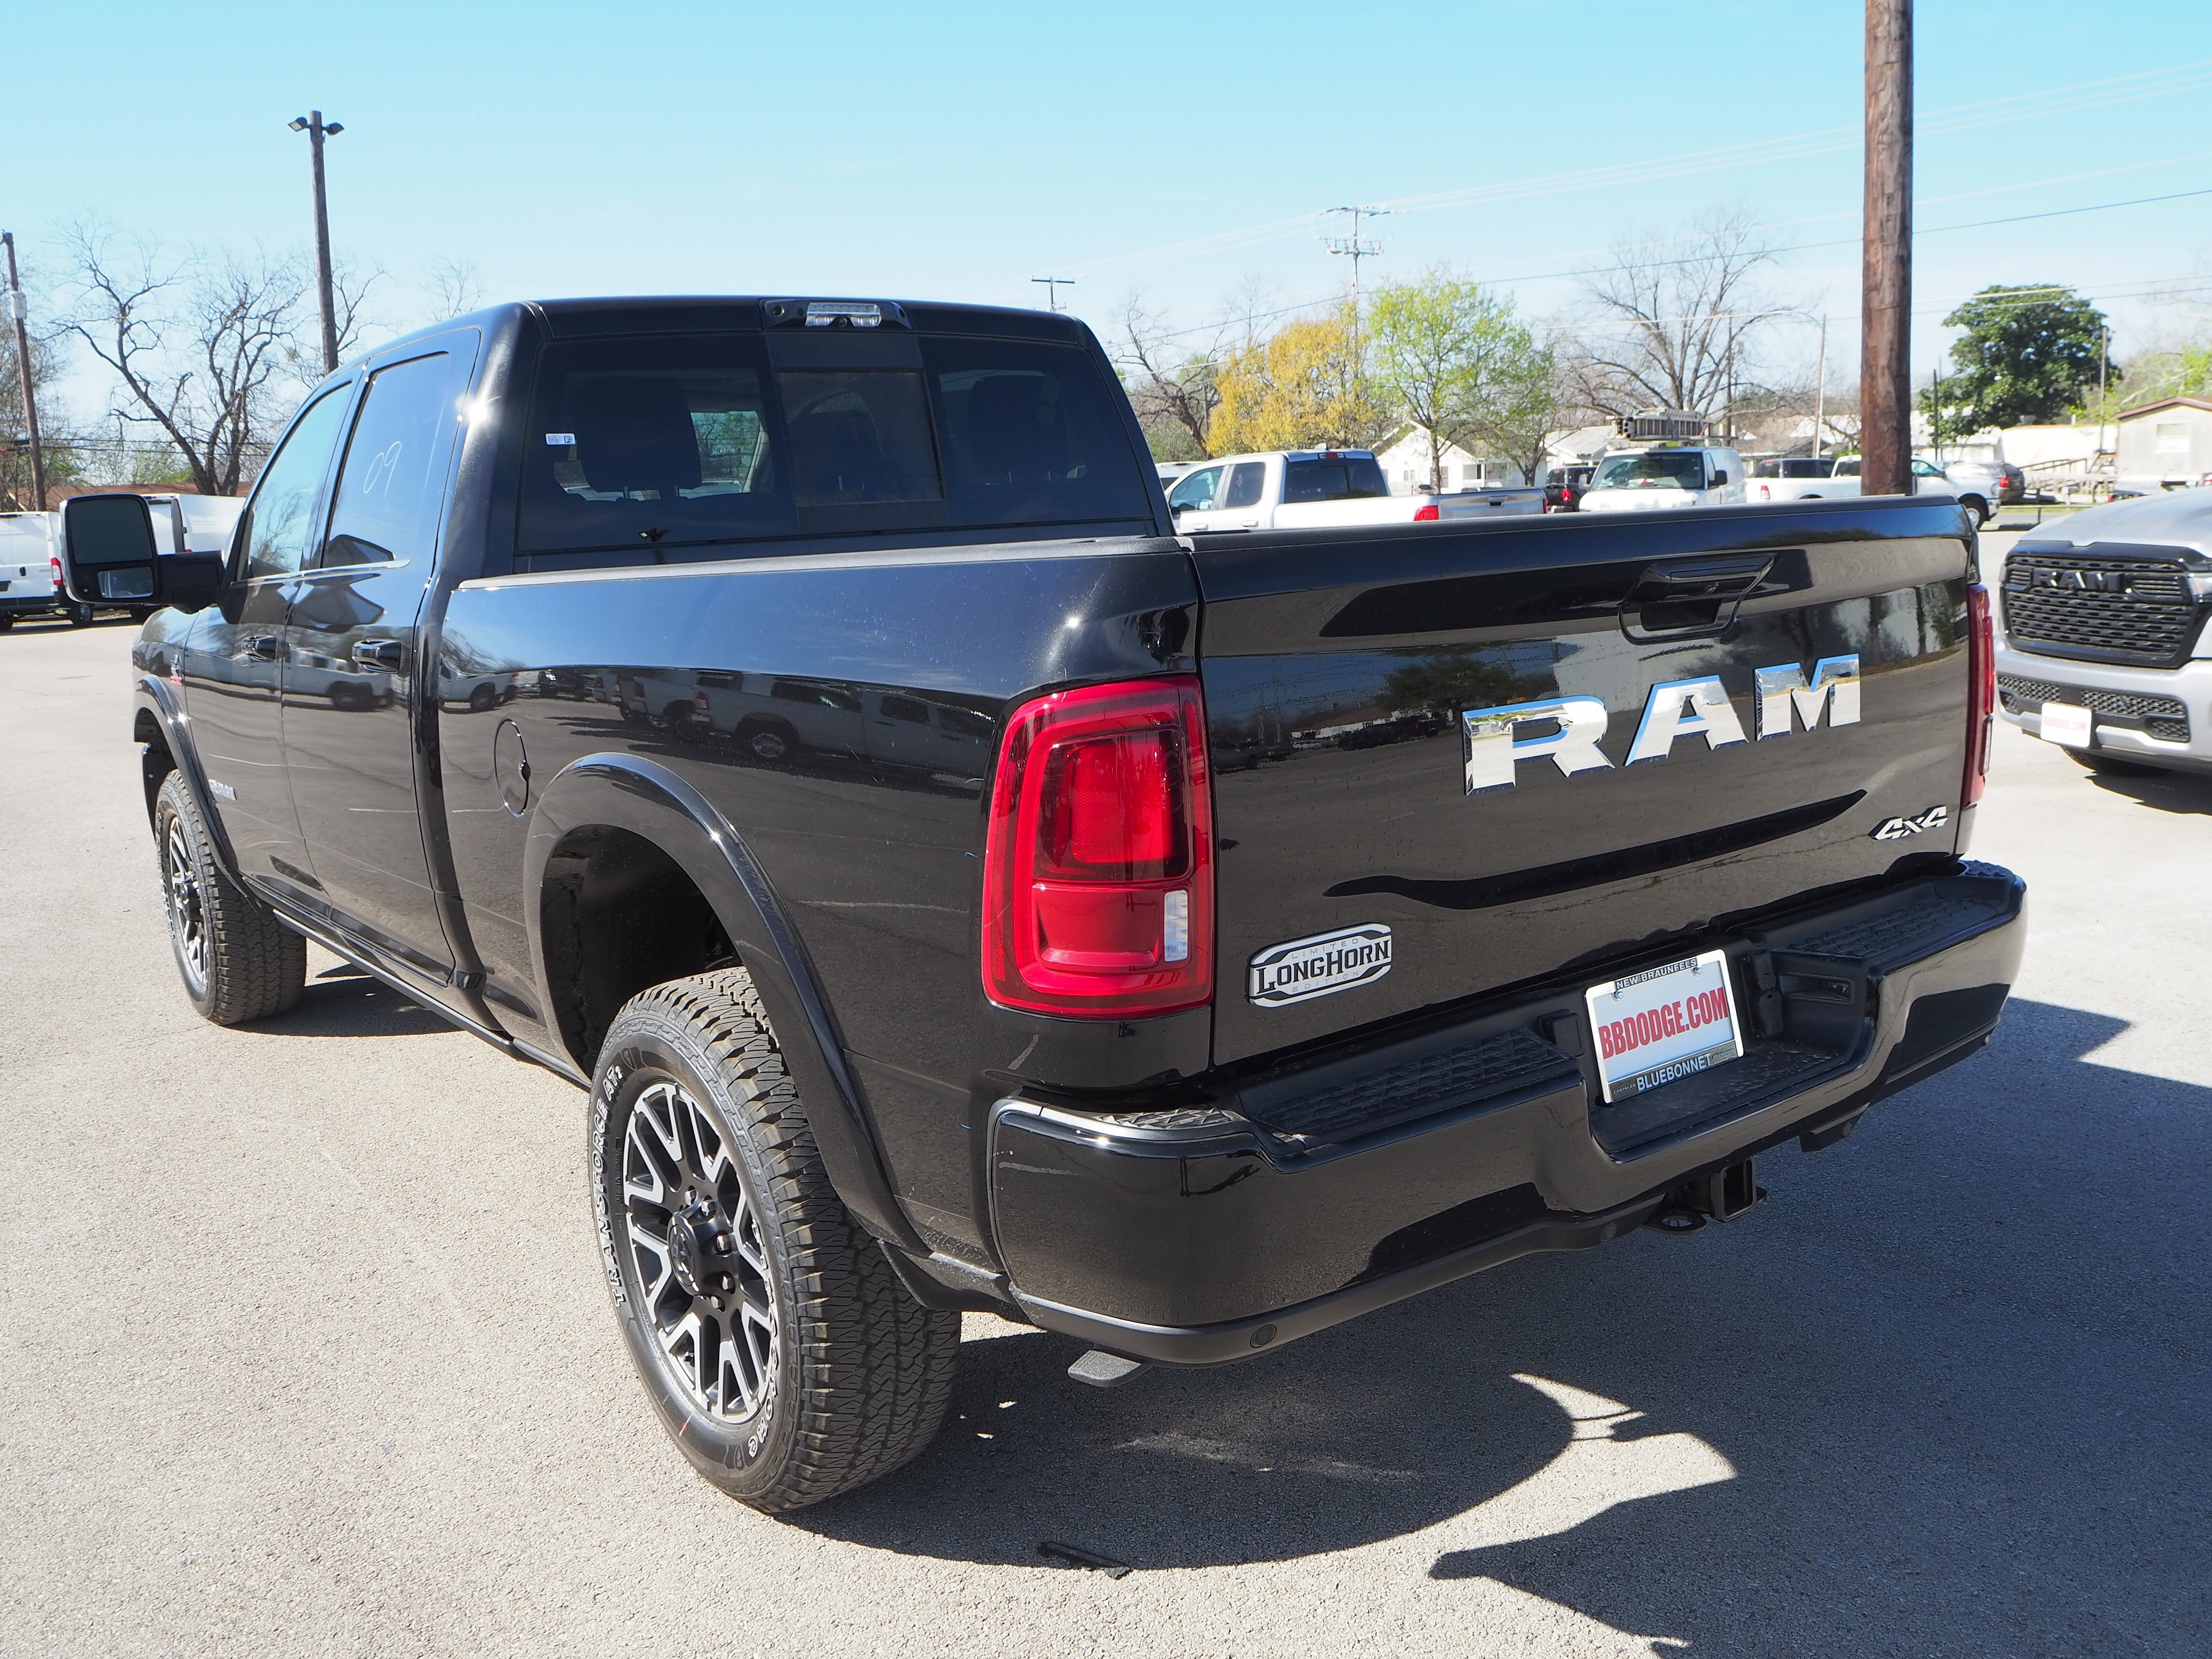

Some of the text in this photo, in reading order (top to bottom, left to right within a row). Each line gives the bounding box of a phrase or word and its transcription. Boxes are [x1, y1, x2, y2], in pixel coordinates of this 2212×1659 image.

[2032, 568, 2125, 593] RAM
[1463, 653, 1861, 796] RAM
[1292, 938, 1358, 959] LIMITED
[1292, 971, 1359, 993] EDITION
[1615, 959, 1697, 990] NEW BRAUNFELS
[1598, 986, 1729, 1060] BBDODGE.COM
[1635, 1054, 1711, 1092] BLUEBONNET
[592, 1097, 626, 1308] TRANSFORCE
